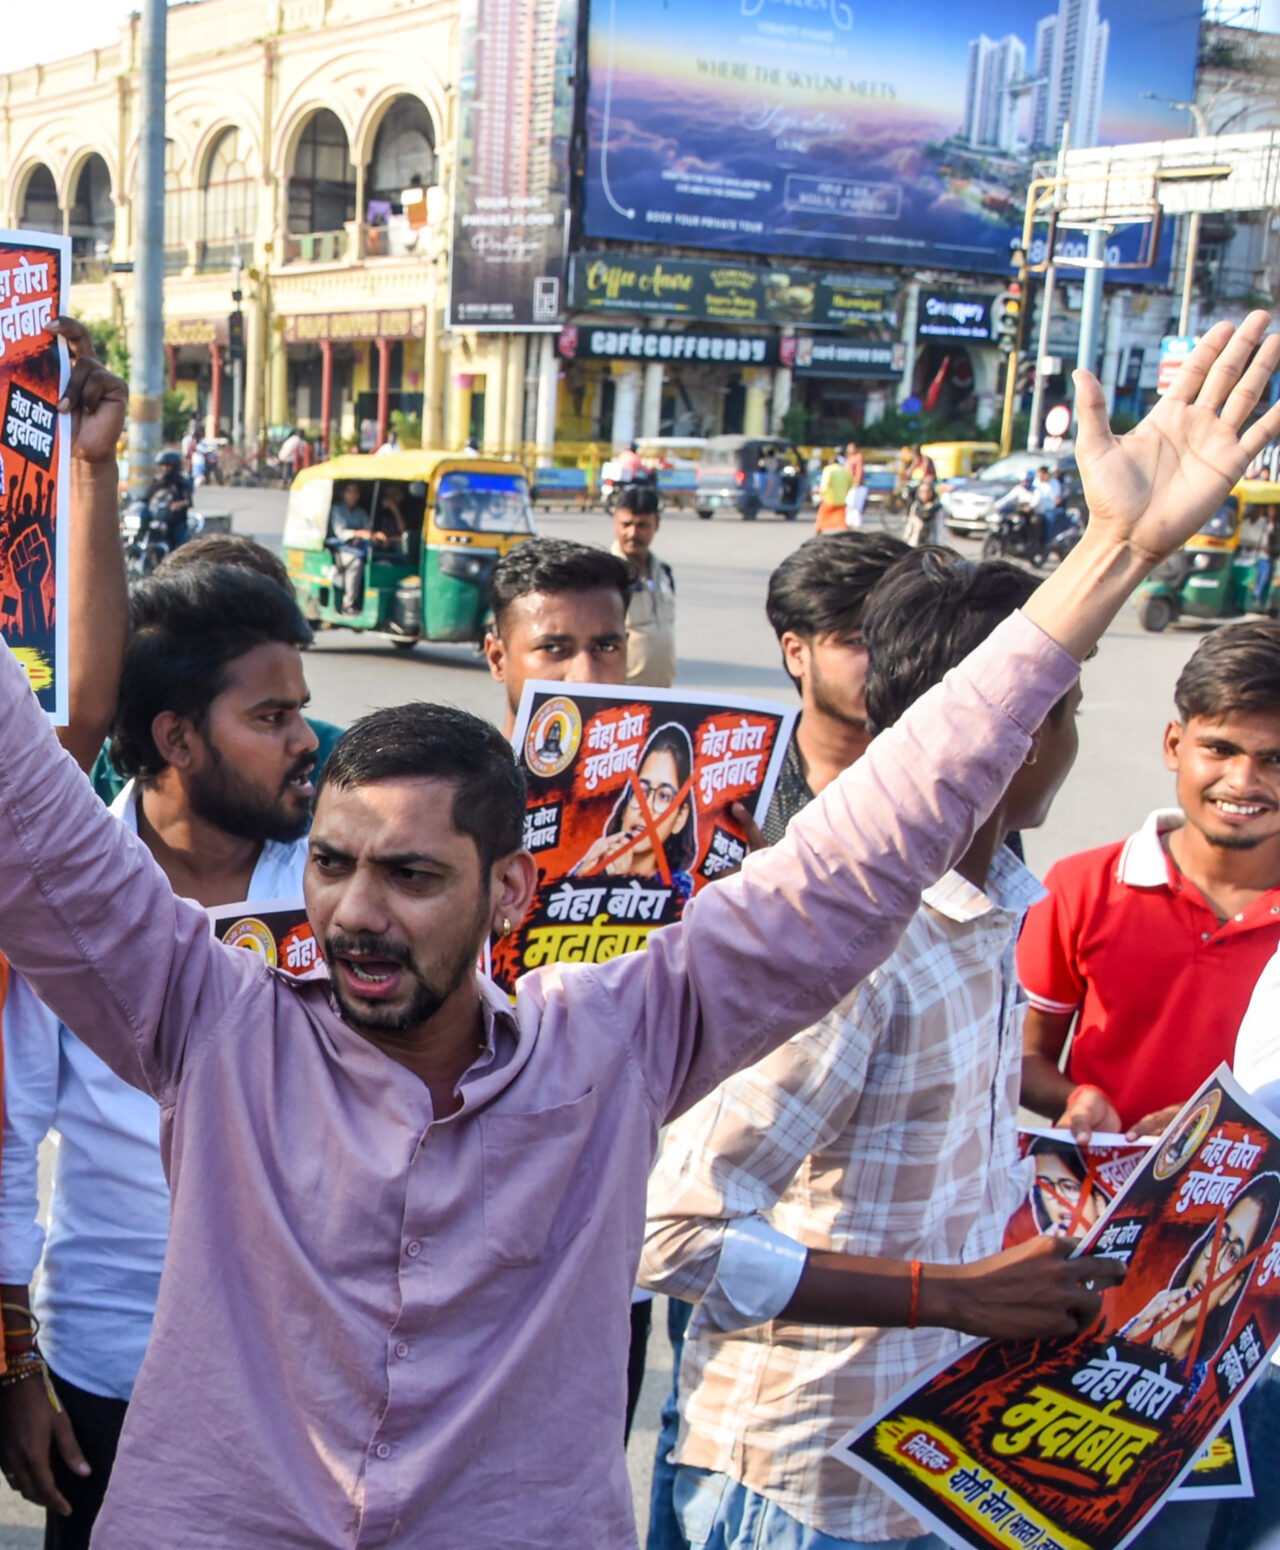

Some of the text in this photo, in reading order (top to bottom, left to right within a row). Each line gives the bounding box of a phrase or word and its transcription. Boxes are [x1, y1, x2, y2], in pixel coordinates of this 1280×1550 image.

[696, 58, 749, 80] WHERE
[13, 256, 48, 293] बोरा
[586, 261, 636, 298] Coffee
[11, 390, 53, 430] नेहा बोरा
[6, 414, 53, 459] मुर्दाबाद
[588, 720, 616, 749] नेहा
[617, 711, 647, 741] बोरा
[701, 719, 767, 758] नेहा बोरा
[584, 743, 640, 790] मुर्दाबाद
[700, 751, 762, 805] मुर्दाबाद
[533, 807, 558, 830] बोरा
[547, 879, 673, 922] नेहा बोरा
[287, 935, 317, 968] नेहा
[1200, 1129, 1233, 1168] नेहा
[1226, 1133, 1262, 1171] बोरा
[1175, 1165, 1243, 1213] मुर्दाबाद
[1071, 1346, 1185, 1420] नेहा बोरा
[992, 1386, 1160, 1487] मुर्दाबाद
[949, 1468, 993, 1503] योगी
[978, 1490, 1016, 1524] सेना
